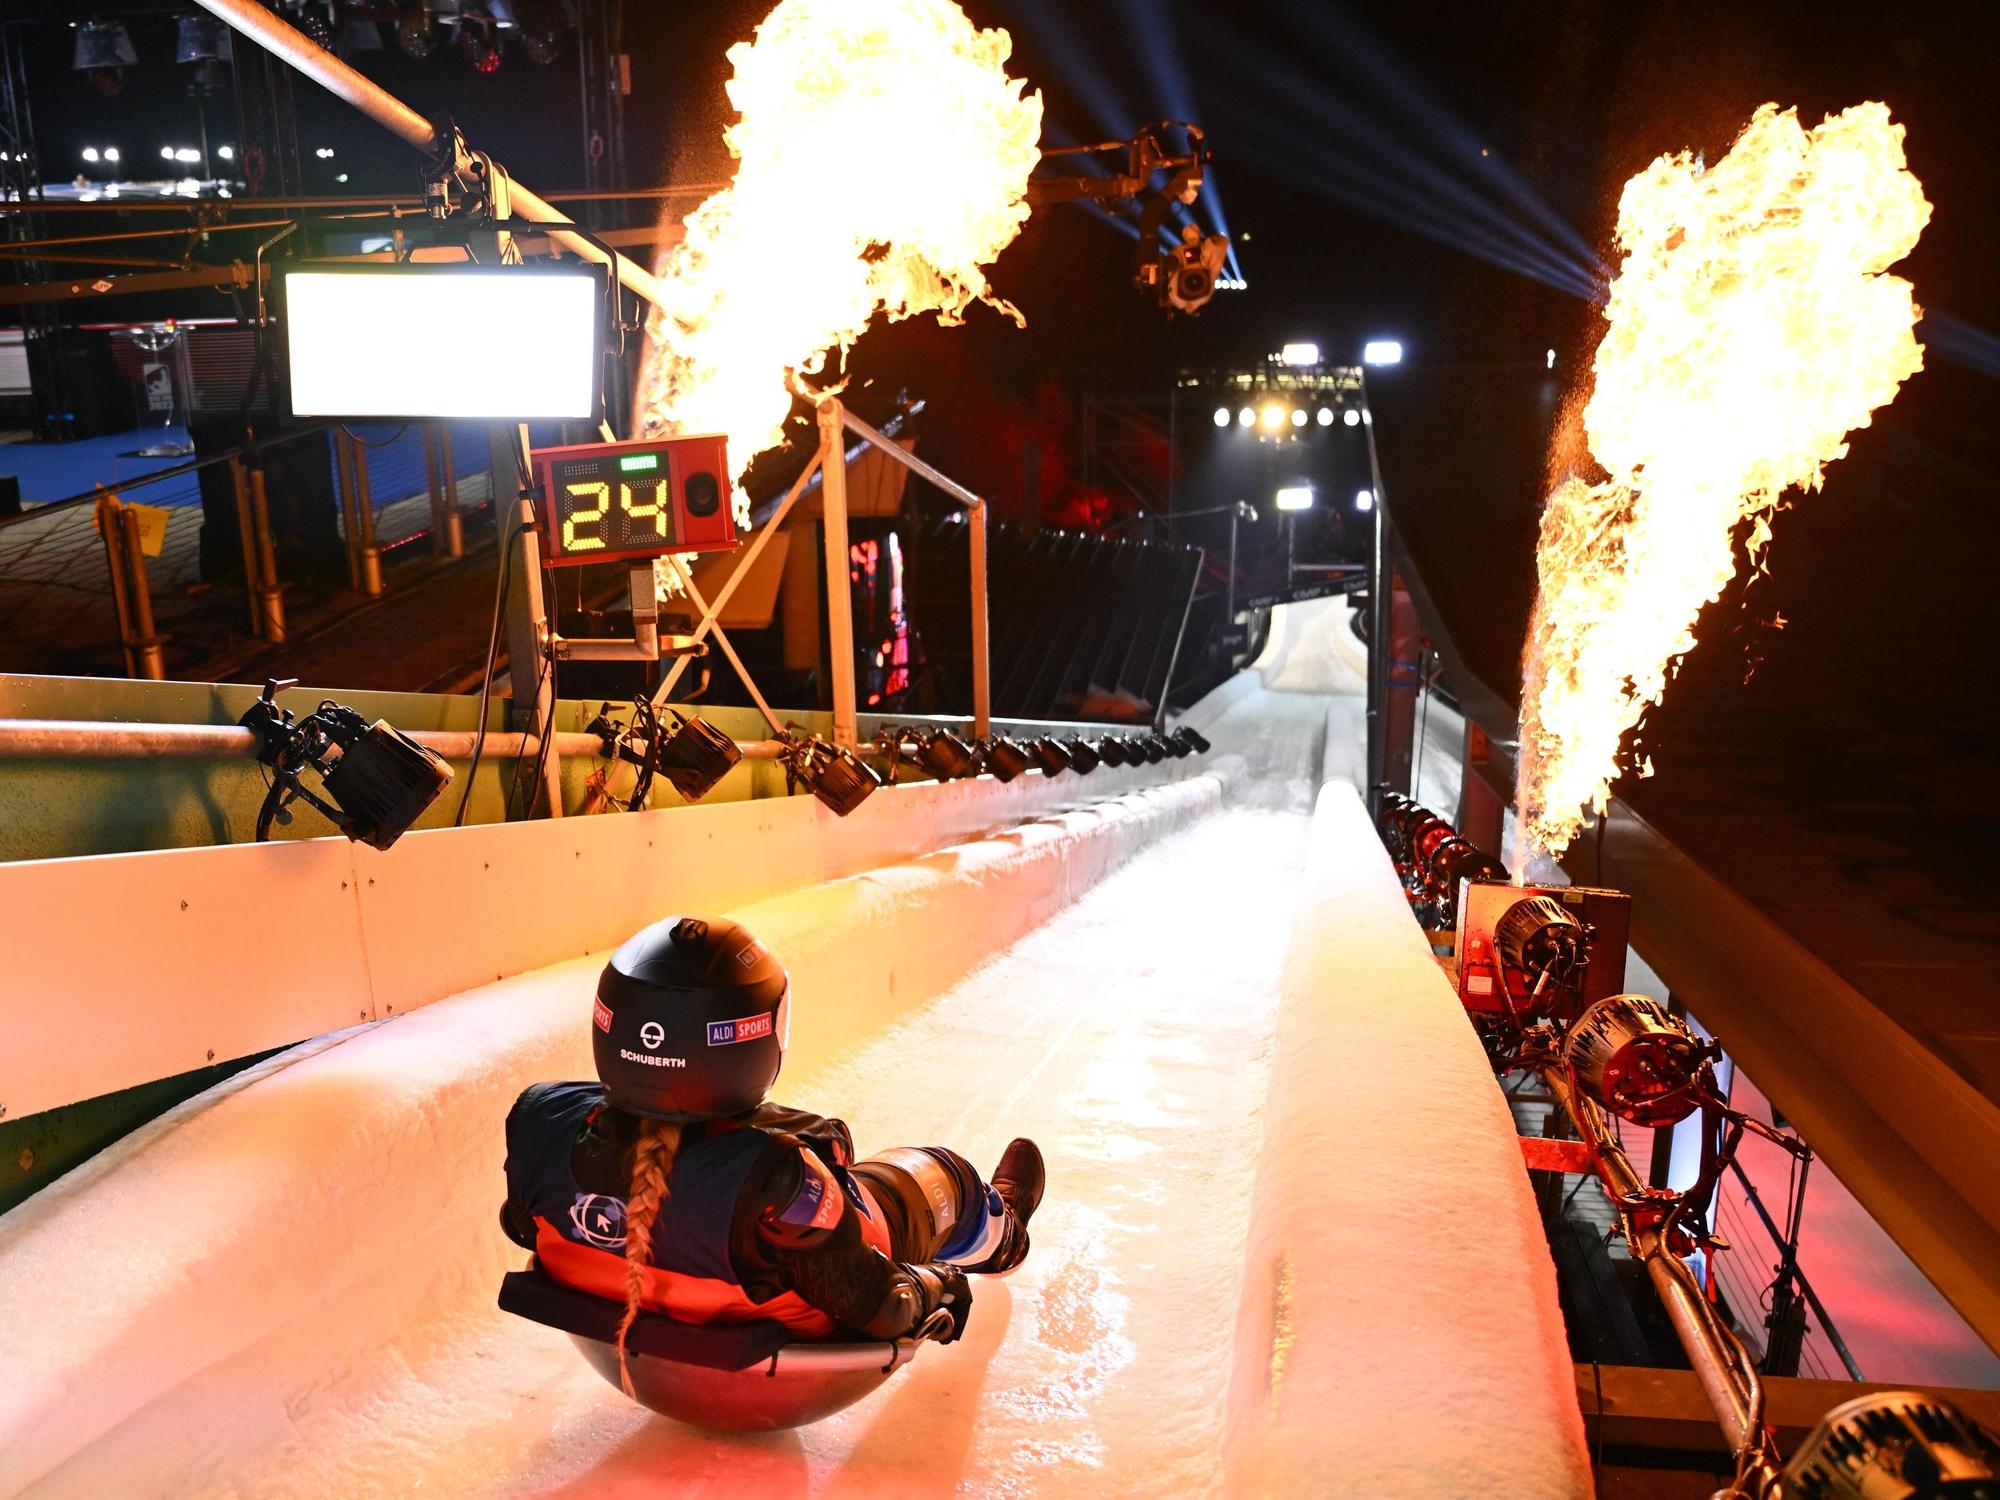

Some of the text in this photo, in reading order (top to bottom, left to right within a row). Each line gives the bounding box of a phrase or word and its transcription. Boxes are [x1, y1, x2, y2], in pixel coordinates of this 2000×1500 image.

[563, 479, 667, 551] 24
[713, 1017, 770, 1041] ALDI SPORTS
[620, 1048, 686, 1068] SCHUBERTH
[930, 1182, 949, 1217] ALDI
